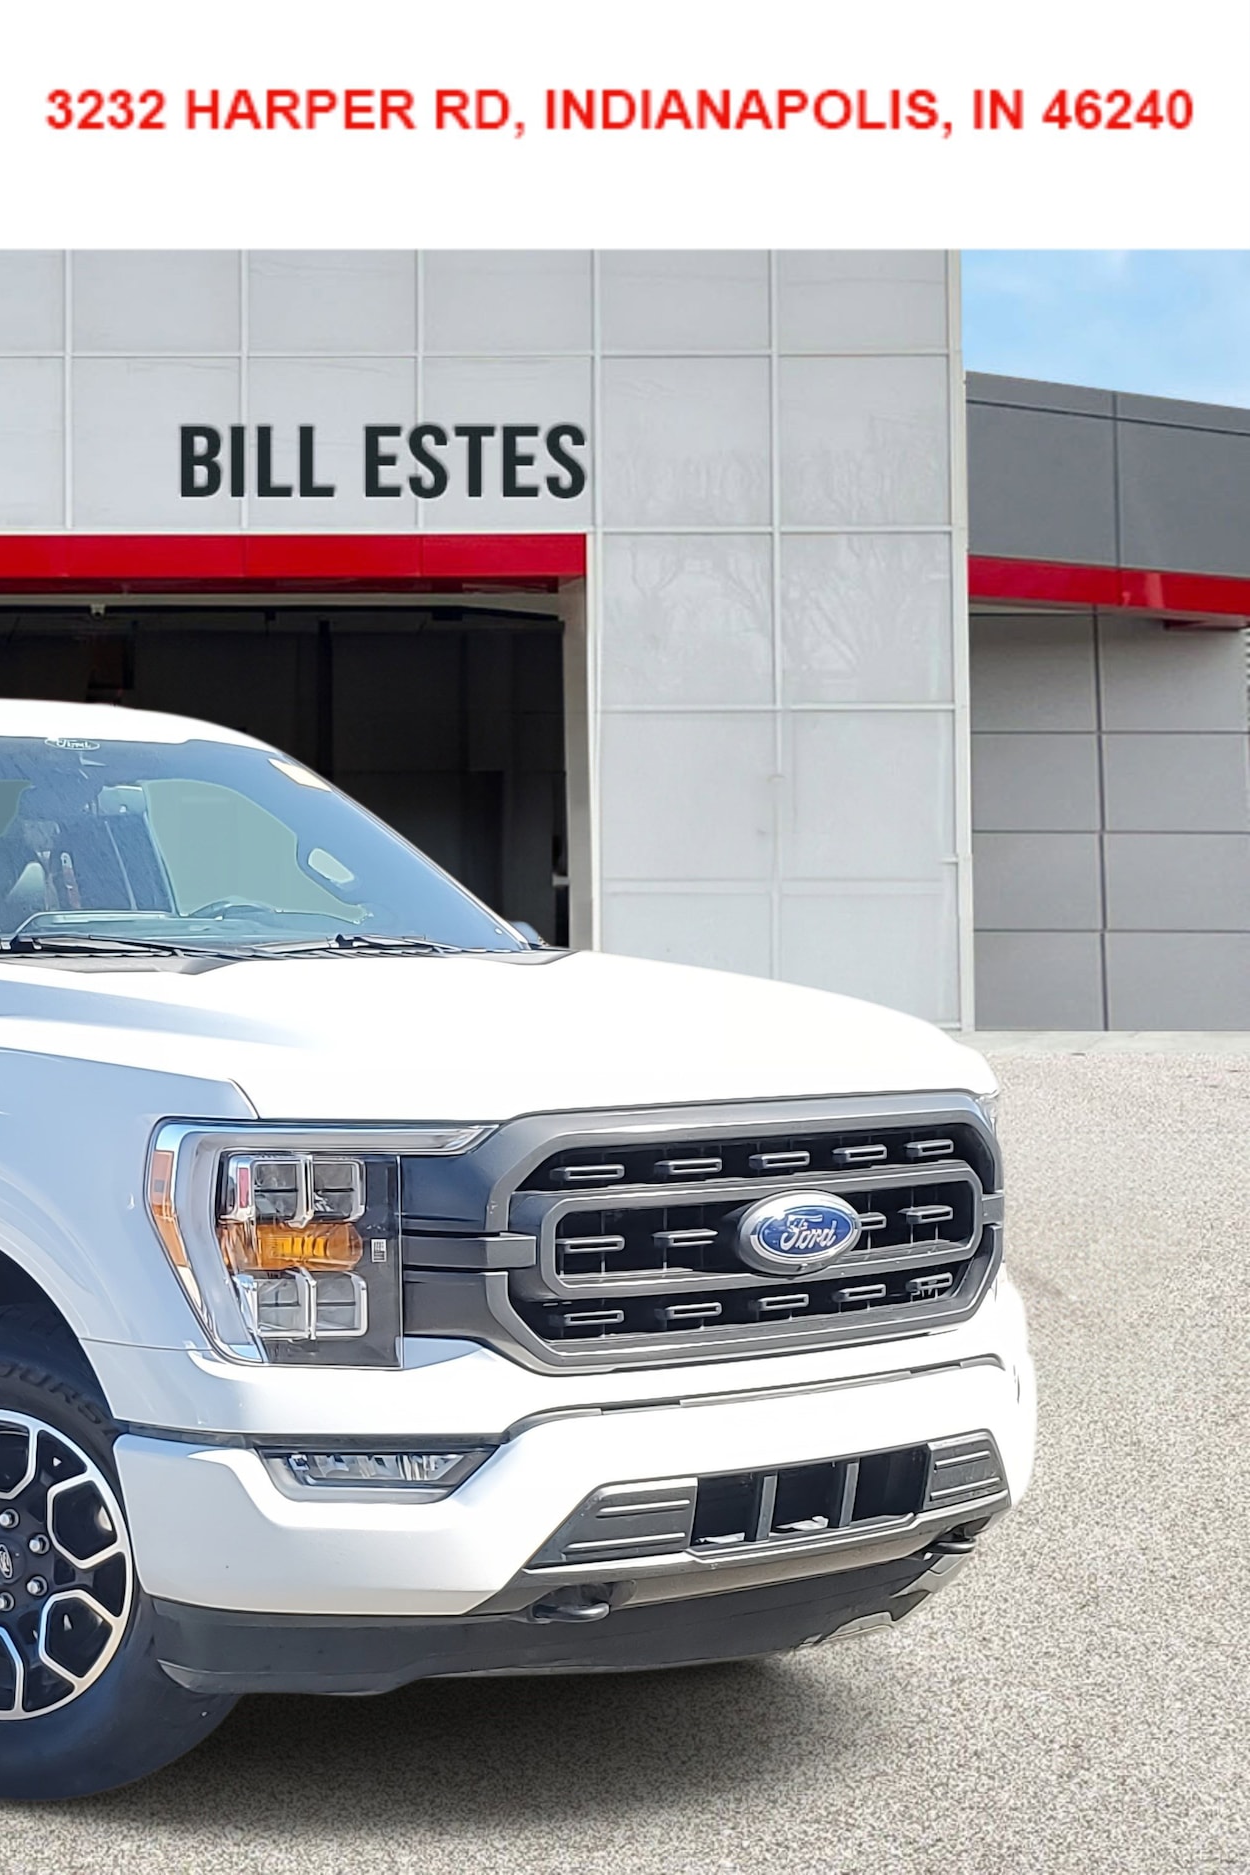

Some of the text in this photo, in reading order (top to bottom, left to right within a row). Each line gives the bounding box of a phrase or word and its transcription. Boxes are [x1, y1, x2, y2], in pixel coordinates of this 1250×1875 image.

[179, 424, 587, 499] BILL ESTES
[780, 1213, 837, 1251] Ford
